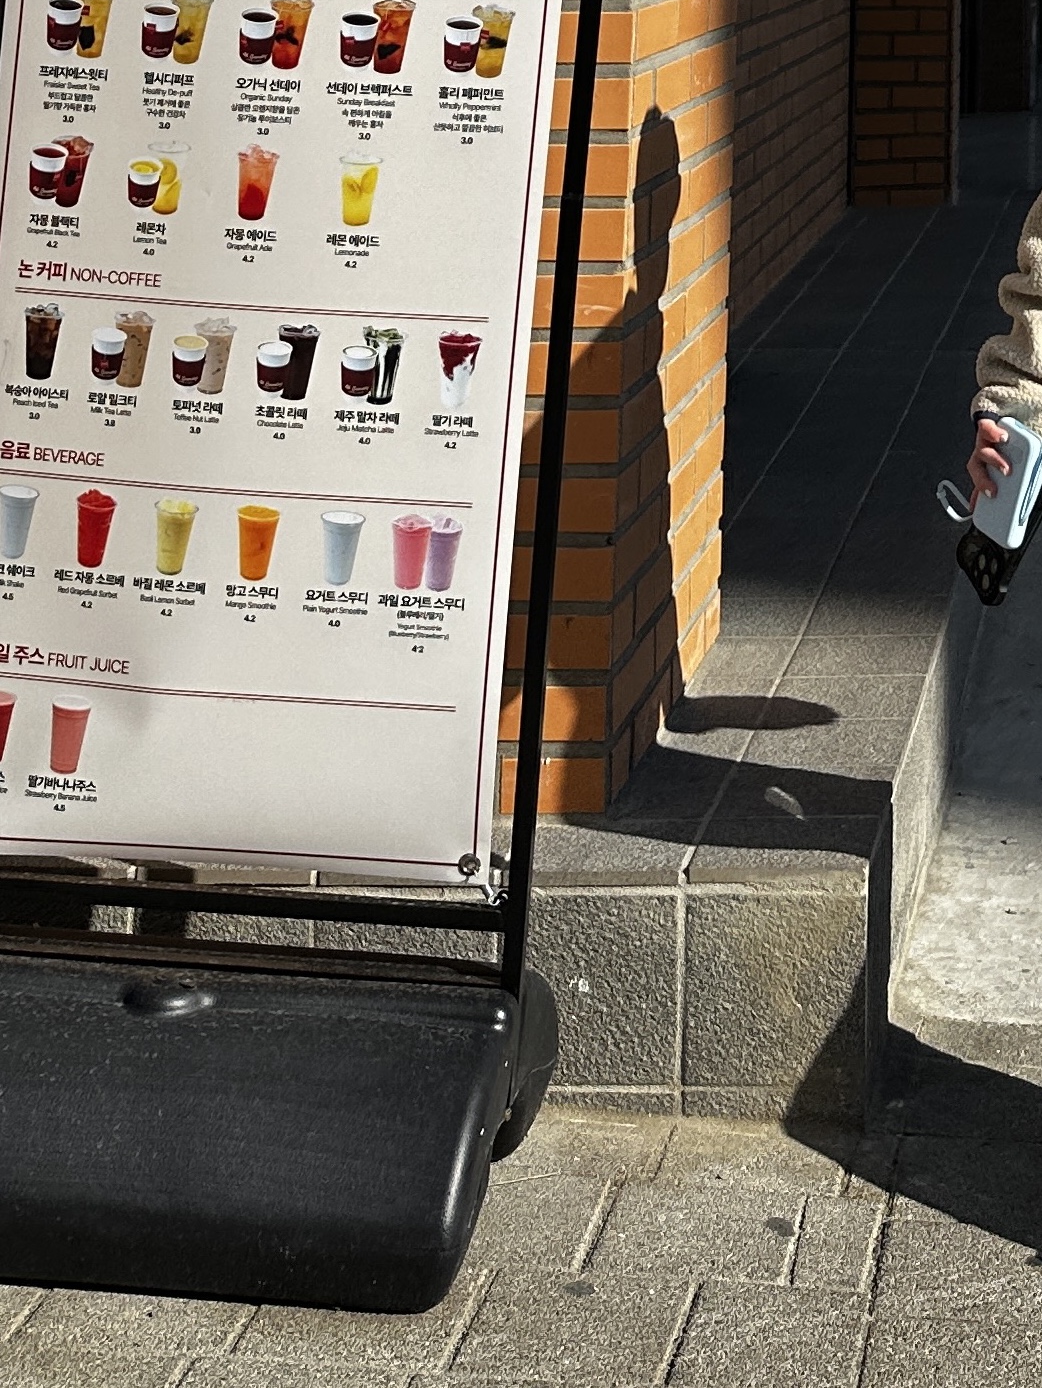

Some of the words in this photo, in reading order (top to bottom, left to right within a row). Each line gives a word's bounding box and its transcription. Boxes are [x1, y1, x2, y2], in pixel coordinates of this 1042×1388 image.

[236, 78, 267, 91] 오가닉
[269, 79, 300, 92] 선데이
[326, 82, 358, 95] 선데이
[63, 115, 74, 123] 3.0
[30, 214, 49, 226] 자몽
[136, 222, 166, 235] 레몬차
[224, 229, 245, 241] 자몽
[247, 230, 277, 242] 에이드
[326, 234, 347, 246] 레몬
[349, 235, 380, 247] 에이드
[70, 268, 162, 287] NON-COFFEE
[5, 384, 32, 397] 복숭아
[33, 387, 69, 401] 아이스티
[109, 394, 137, 407] 밀크티
[172, 400, 201, 413] 토피넛
[203, 402, 223, 414] 라떼
[255, 406, 285, 418] 초콜릿
[287, 408, 307, 419] 라떼
[334, 410, 355, 422] 제주
[379, 413, 400, 425] 라떼
[432, 415, 451, 426] 딸기
[454, 416, 473, 427] 라떼
[0, 441, 30, 459] 음료
[33, 447, 104, 466] BEVERAGE
[7, 564, 35, 577] 쉐이크
[54, 569, 73, 581] 레드
[75, 571, 94, 584] 자몽
[95, 574, 125, 587] 소르베
[133, 577, 153, 590] 바질
[154, 579, 174, 592] 레몬
[175, 581, 206, 595] 소르베
[226, 585, 246, 597] 망고
[248, 587, 278, 599] 스무디
[305, 590, 337, 602] 요거트
[337, 592, 368, 605] 스무디
[378, 594, 399, 607] 과일
[400, 596, 432, 608] 요거트
[433, 598, 465, 611] 스무디
[13, 646, 44, 665] 주스
[48, 653, 87, 669] FRUIT
[89, 658, 129, 674] JUICE
[27, 775, 96, 793] 딸기바나나주스
